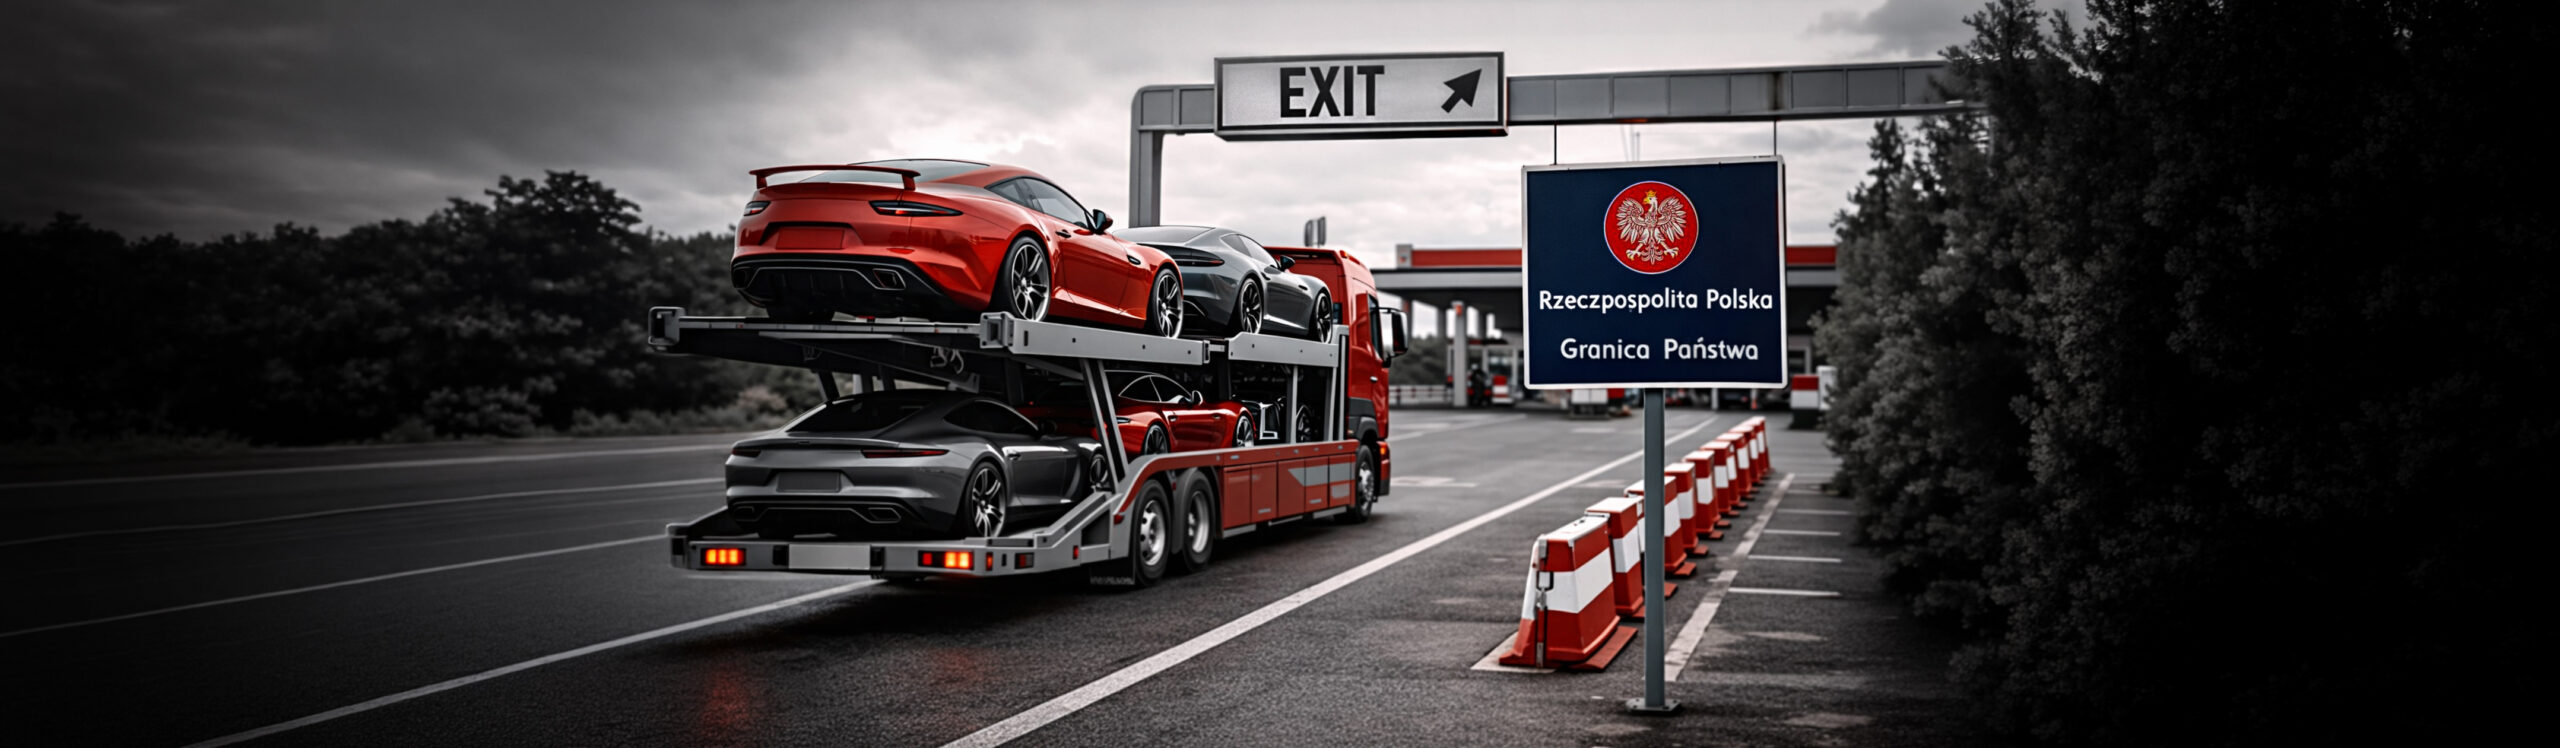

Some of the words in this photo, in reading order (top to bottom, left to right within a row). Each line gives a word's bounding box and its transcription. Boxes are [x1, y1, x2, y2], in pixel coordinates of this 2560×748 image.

[1280, 65, 1385, 118] EXIT
[1539, 287, 1698, 314] Rzeczpospolita
[1706, 287, 1773, 310] Polska
[1560, 337, 1650, 360] Granica
[1664, 336, 1758, 360] Państwa
